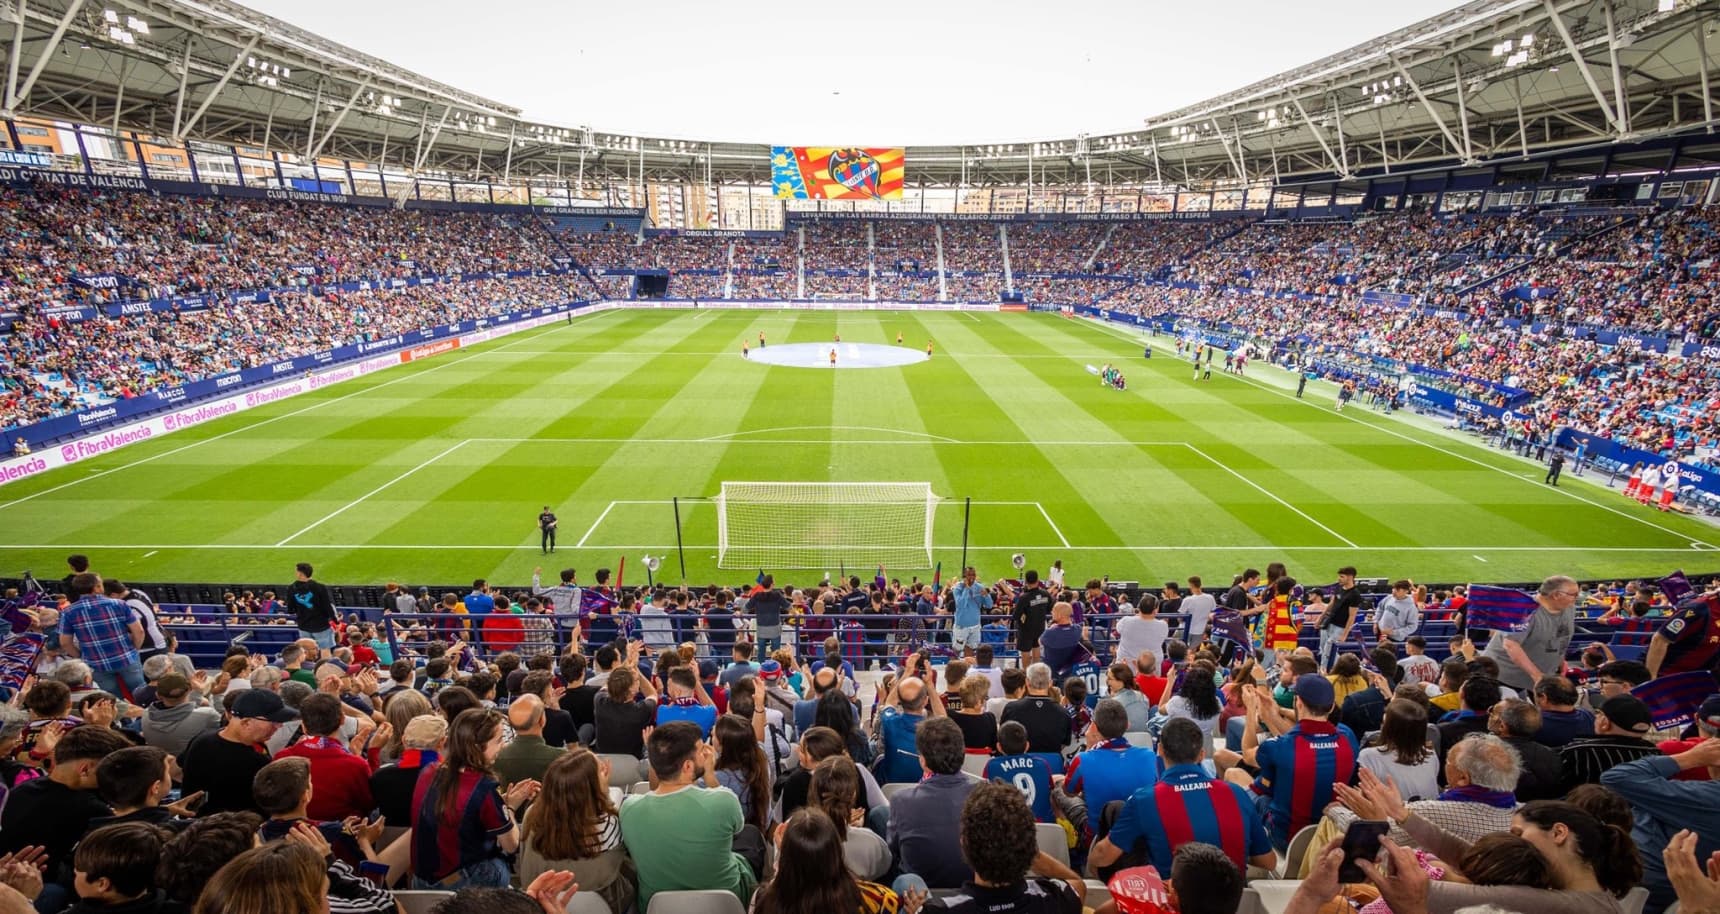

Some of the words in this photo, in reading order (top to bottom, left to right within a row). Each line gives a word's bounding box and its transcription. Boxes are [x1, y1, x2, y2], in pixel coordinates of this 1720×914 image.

[0, 169, 16, 180] DI
[71, 175, 87, 186] DE
[266, 189, 287, 199] CLUB
[288, 191, 318, 201] FUNDAT
[121, 302, 152, 314] AMSTEL
[1000, 758, 1034, 772] MARC
[1012, 772, 1036, 806] 9
